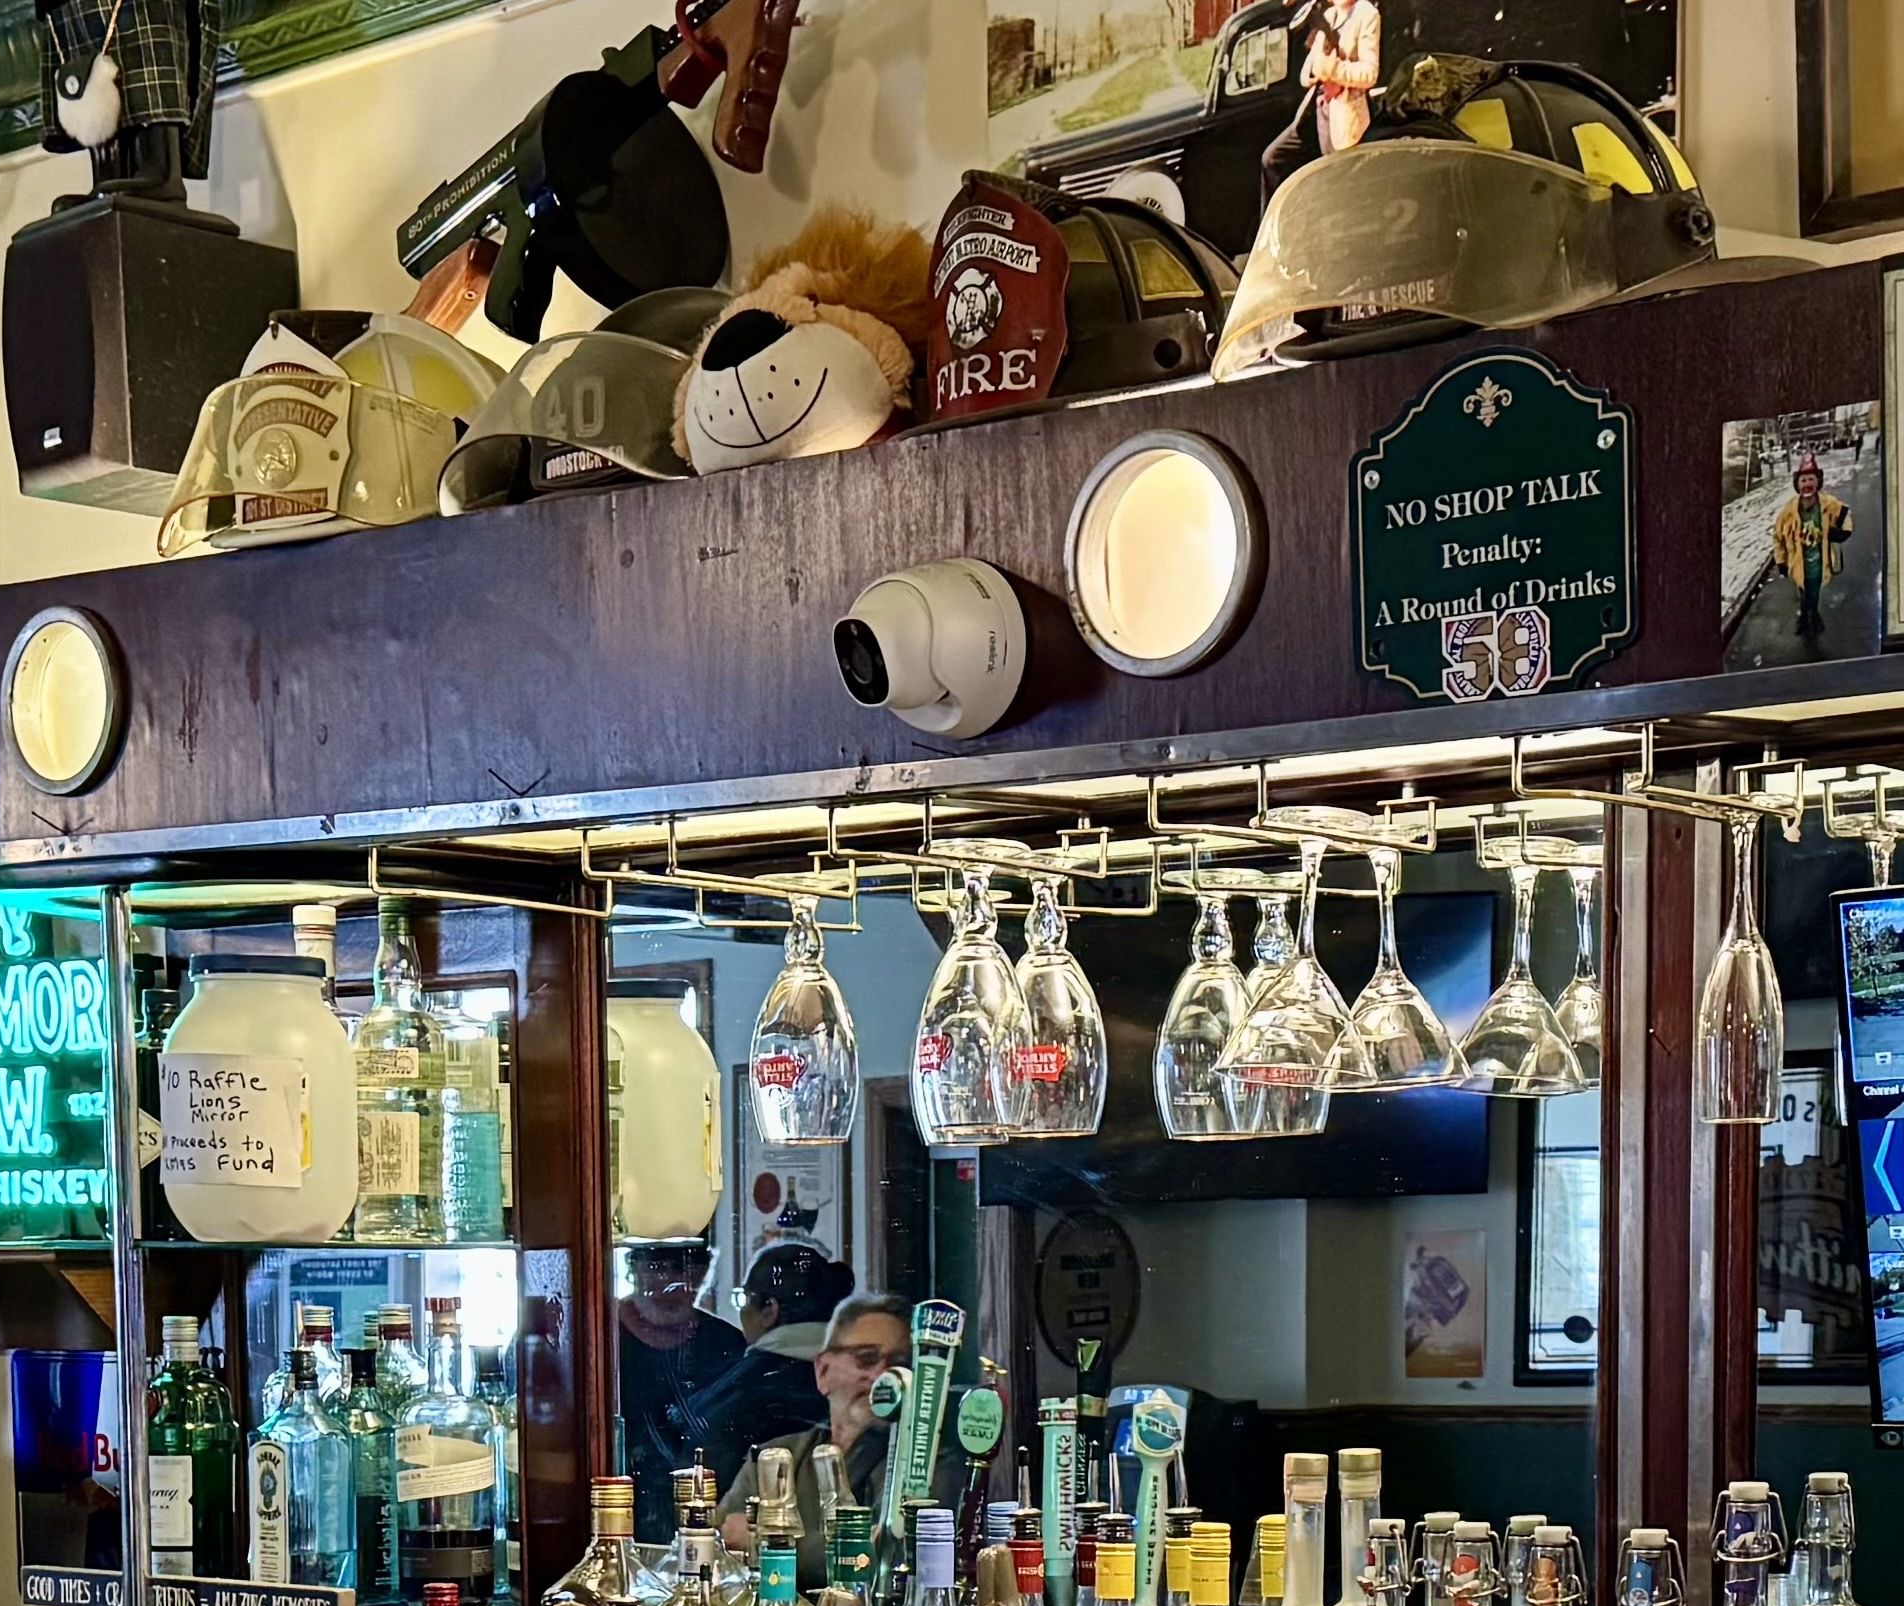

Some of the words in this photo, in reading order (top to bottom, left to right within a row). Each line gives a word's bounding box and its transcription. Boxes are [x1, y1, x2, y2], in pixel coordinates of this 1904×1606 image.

[432, 151, 508, 217] PROHIBITION
[936, 349, 1036, 411] FIRE
[1386, 500, 1426, 529] NO
[1435, 485, 1513, 522] SHOP
[1521, 470, 1602, 506] TALK
[1442, 534, 1542, 569] Penalty:
[1374, 601, 1394, 626] A
[1402, 588, 1483, 623] Round
[1492, 582, 1520, 610] of
[1525, 570, 1616, 605] Drinks
[1442, 605, 1550, 703] 58
[190, 1093, 241, 1109] Lions
[218, 1147, 274, 1173] Fund
